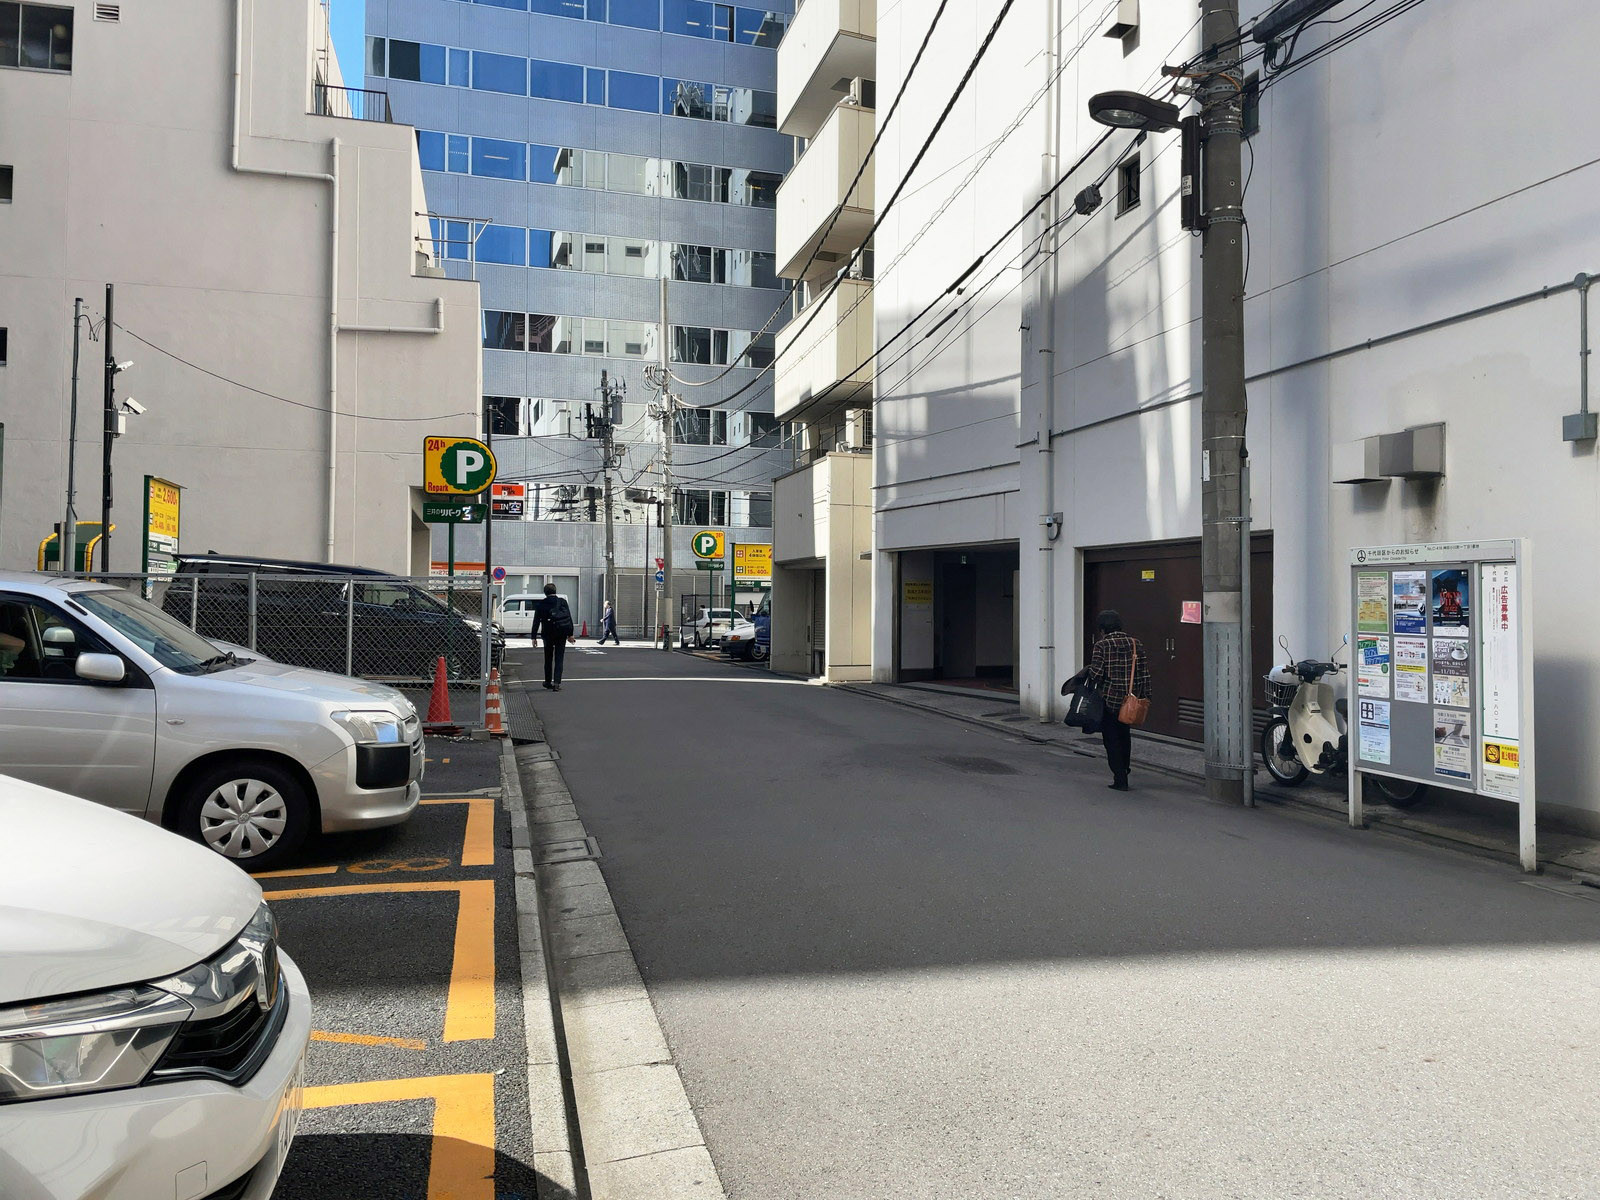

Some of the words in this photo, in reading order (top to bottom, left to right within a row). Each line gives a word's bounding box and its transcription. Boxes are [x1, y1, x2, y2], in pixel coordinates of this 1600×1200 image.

[428, 439, 446, 451] 24h
[456, 449, 484, 484] P
[428, 482, 449, 492] Repark
[701, 536, 715, 554] P
[1500, 585, 1509, 632] 広告募集中
